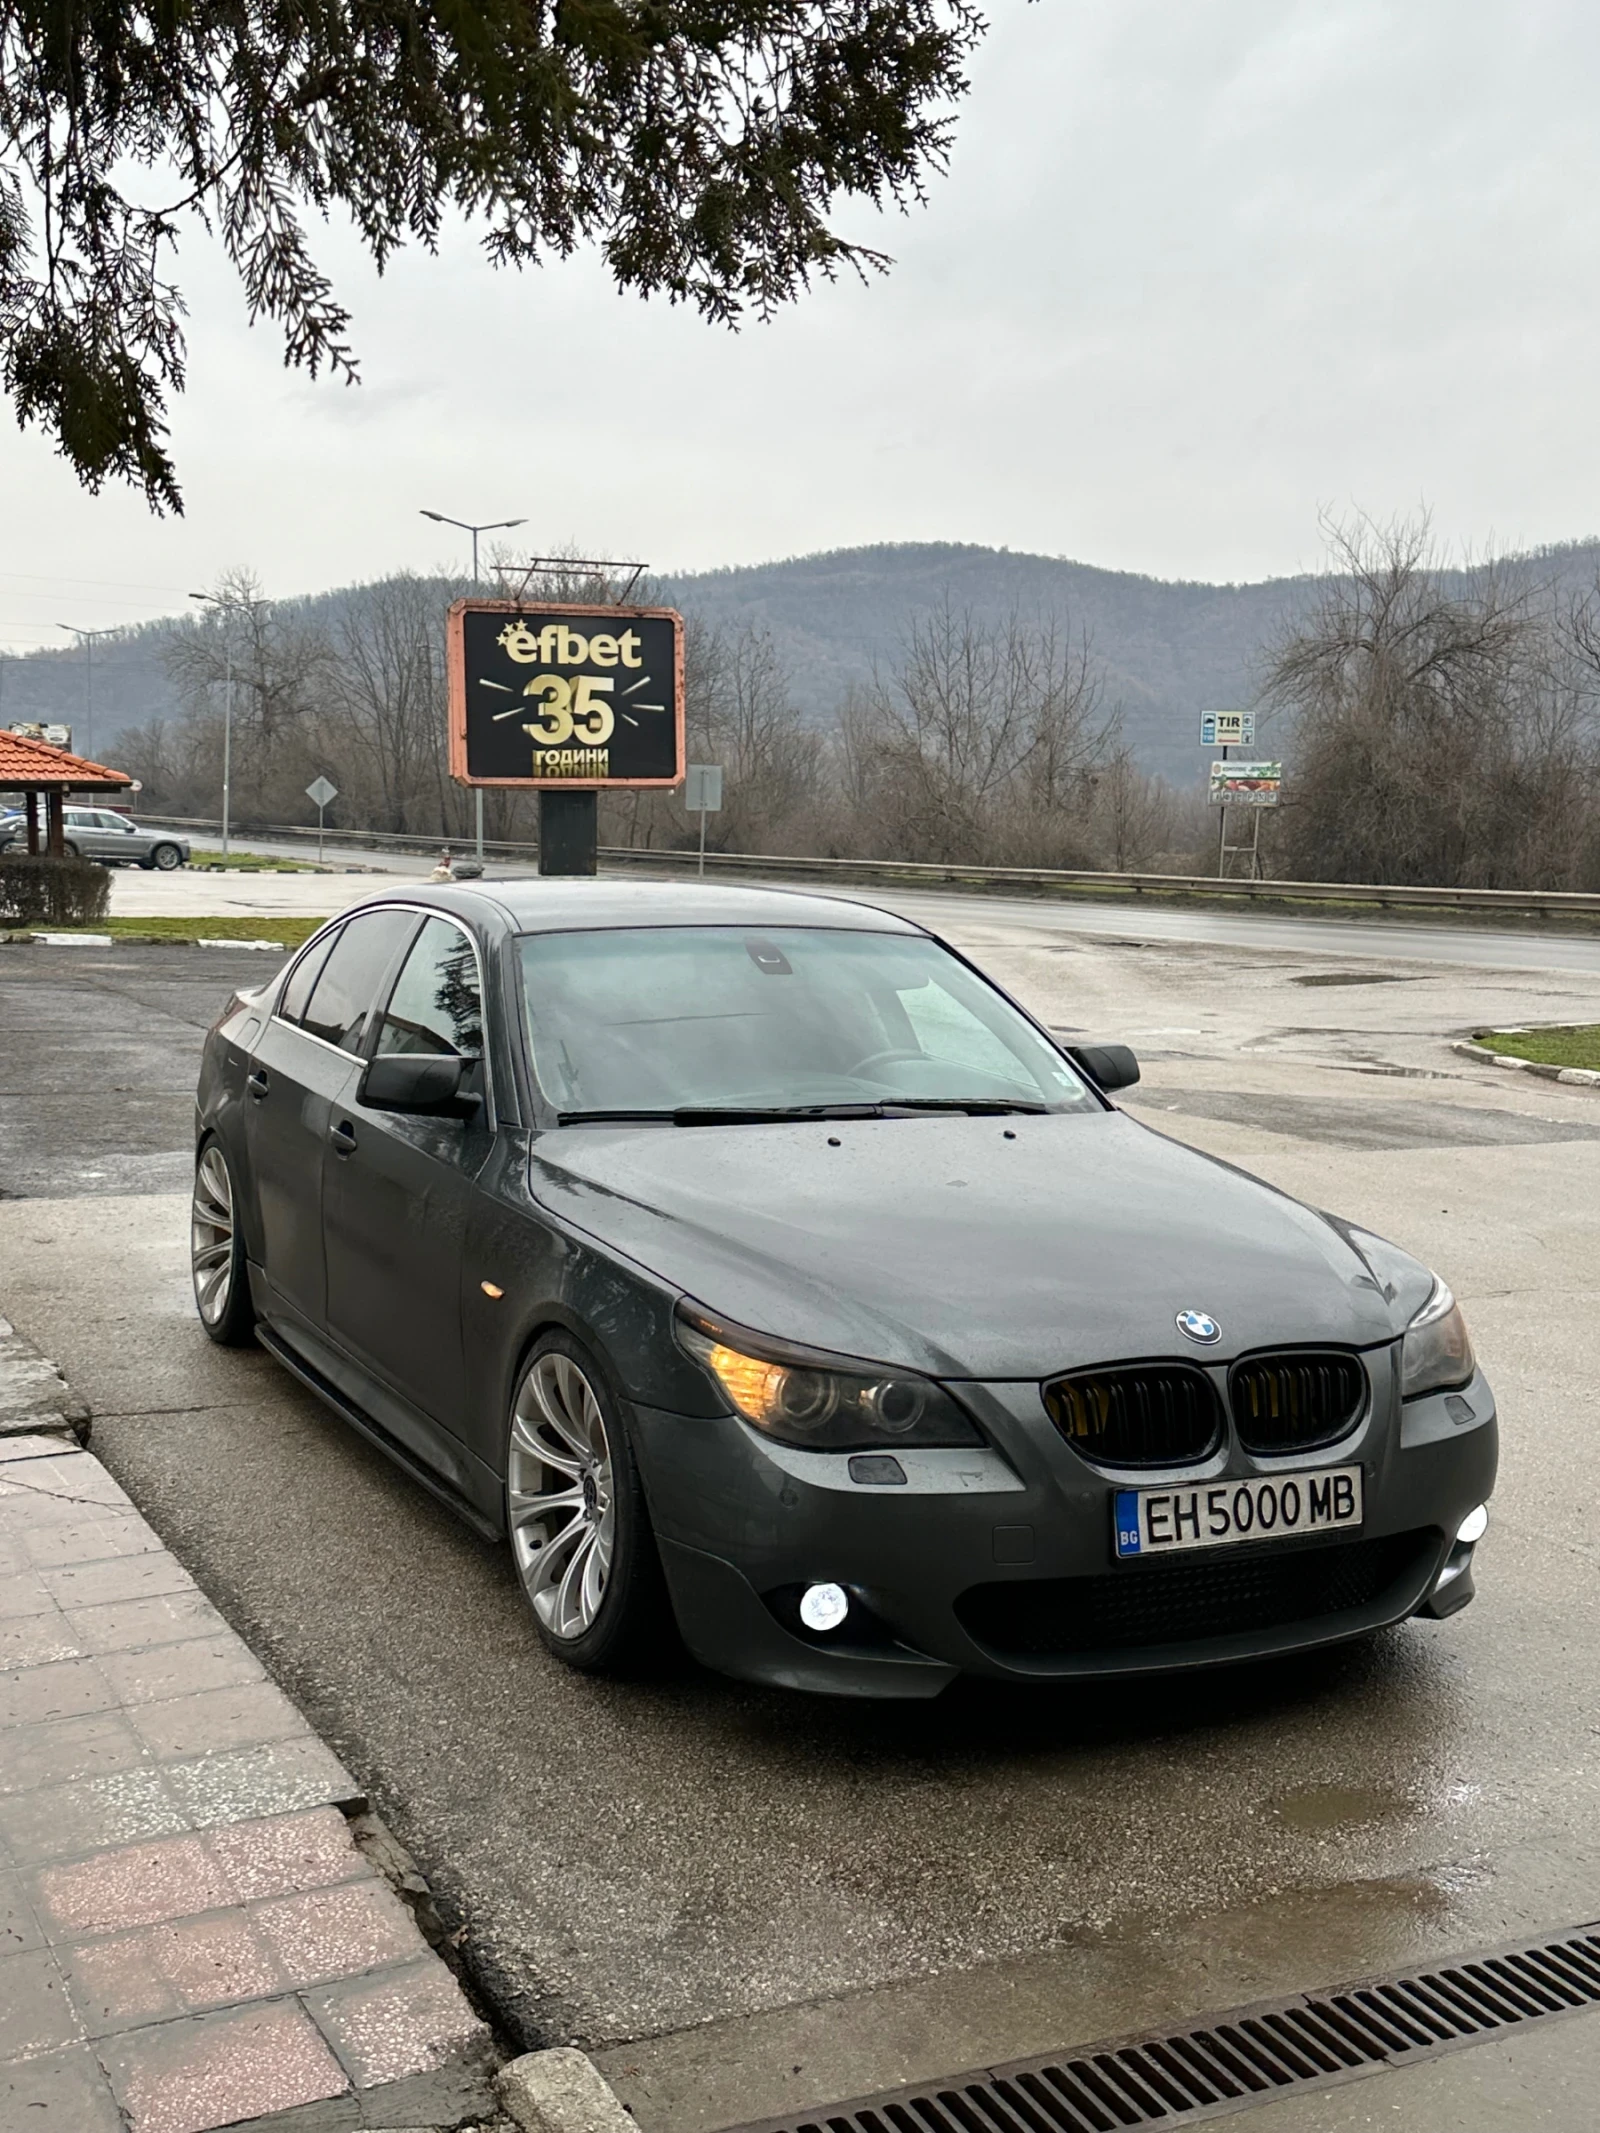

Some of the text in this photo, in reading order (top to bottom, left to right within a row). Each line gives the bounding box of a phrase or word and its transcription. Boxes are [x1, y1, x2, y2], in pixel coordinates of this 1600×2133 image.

[506, 624, 642, 668] efbet
[522, 674, 615, 745] 35
[1218, 716, 1240, 728] TIR
[1120, 1530, 1138, 1546] BG
